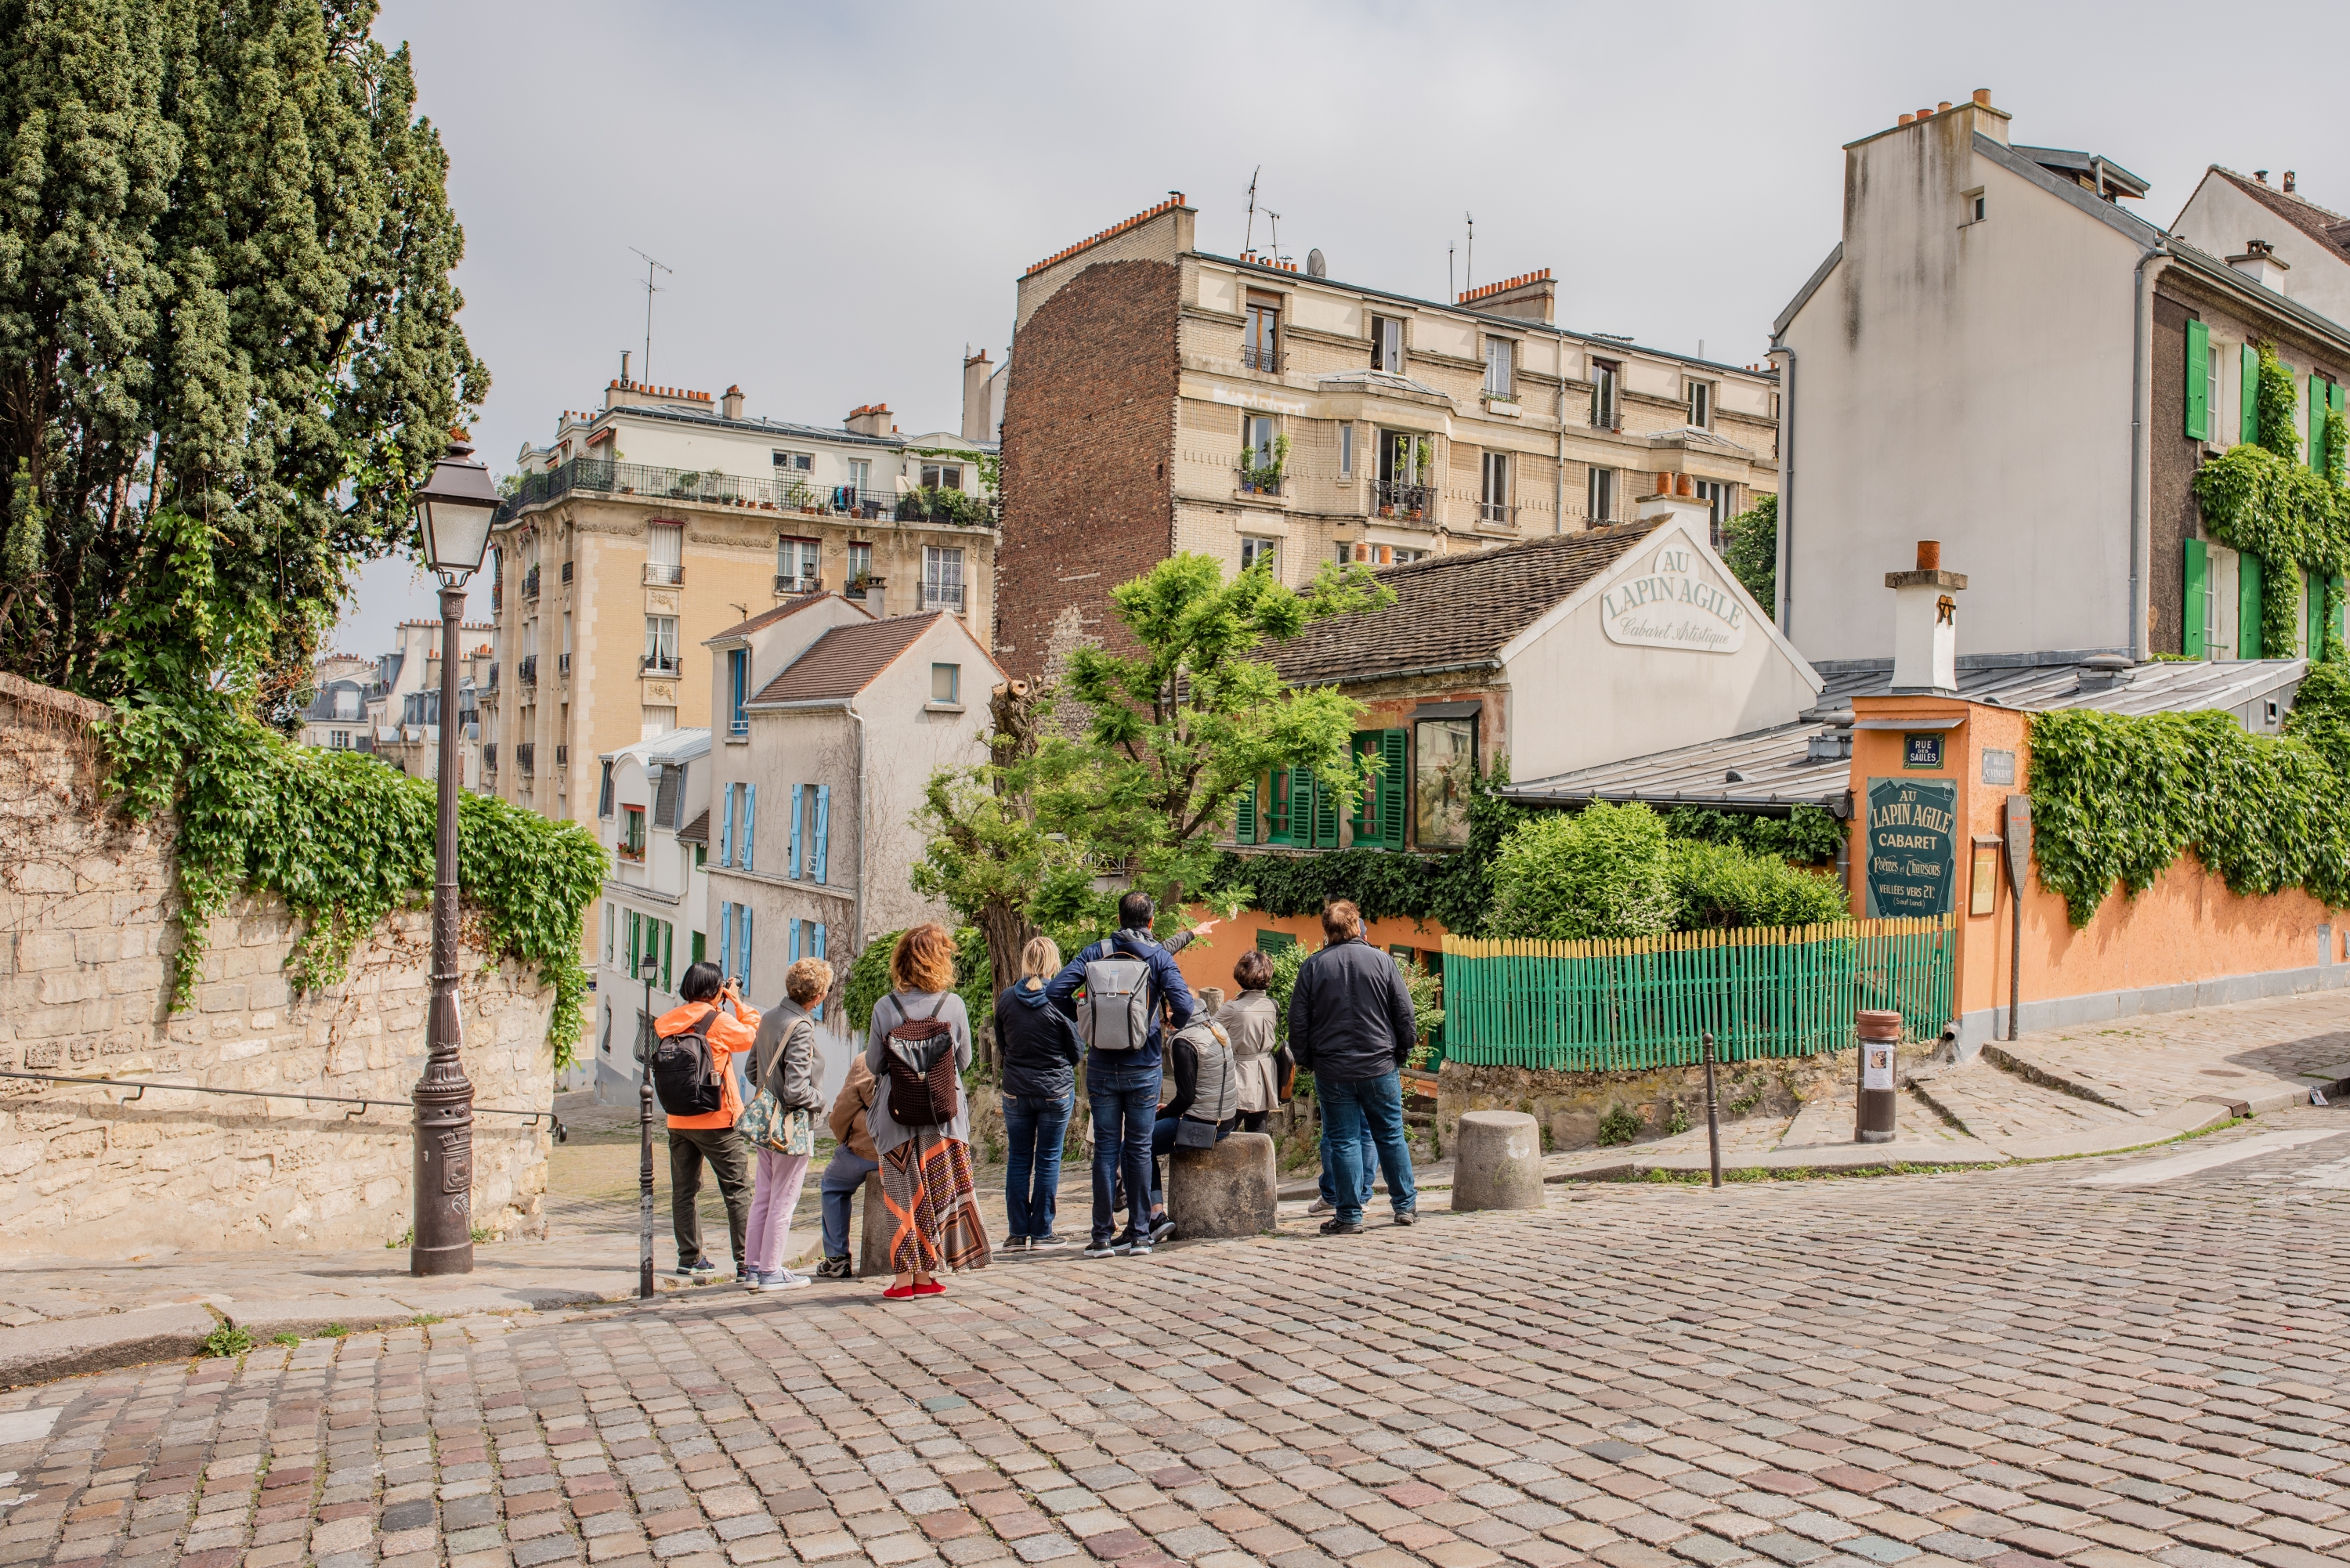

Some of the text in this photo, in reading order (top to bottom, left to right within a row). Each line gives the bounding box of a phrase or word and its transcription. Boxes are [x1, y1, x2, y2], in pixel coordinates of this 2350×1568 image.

[1662, 551, 1690, 573] AU
[1603, 576, 1744, 630] LAPIN AGILE
[1620, 617, 1730, 650] Cabaret Artistique
[1915, 740, 1932, 749] RUE
[1910, 753, 1936, 762] SAULES
[1994, 757, 2004, 765] RUE
[1898, 790, 1917, 801] AU
[1872, 803, 1952, 834] LAPIN AGILE
[1878, 833, 1937, 850] CABARET
[1874, 856, 1899, 873] Poèmes
[1906, 860, 1941, 876] Chansons
[1878, 883, 1904, 895] VEILLÉES
[1906, 887, 1922, 898] VERS
[1893, 897, 1925, 909] (Sauf Lundi)
